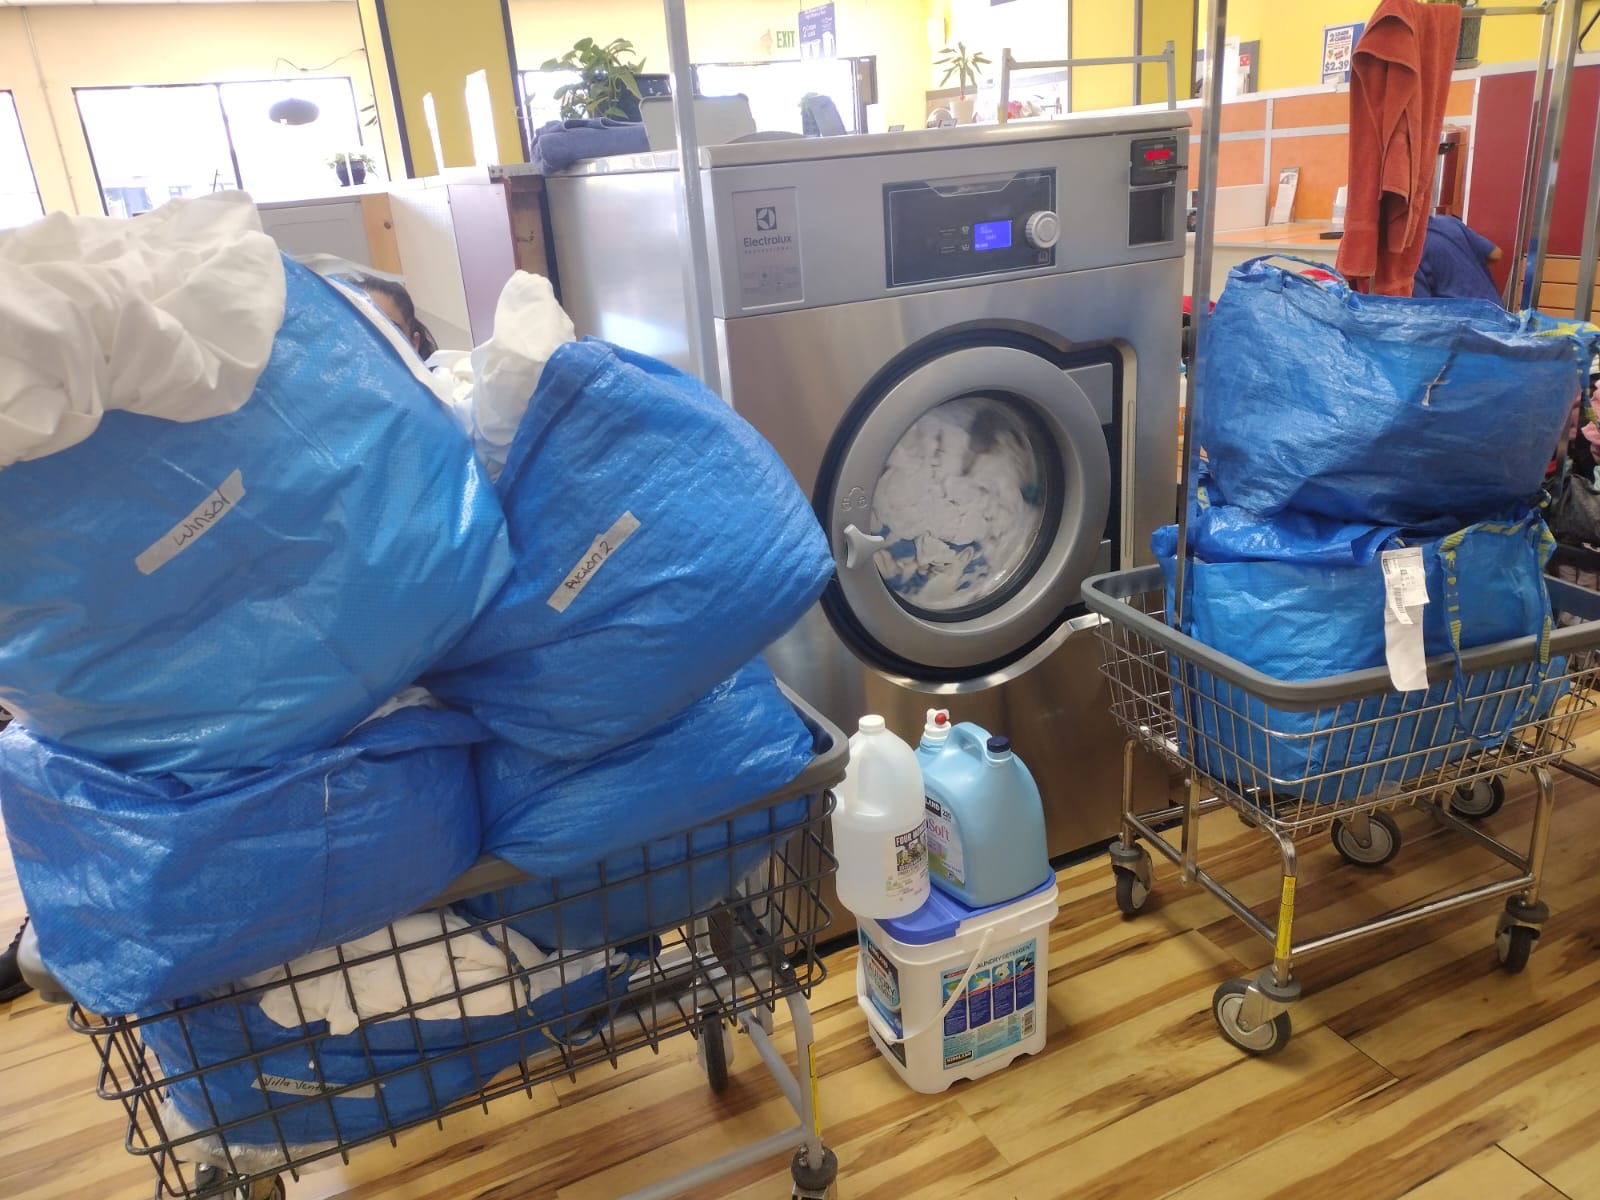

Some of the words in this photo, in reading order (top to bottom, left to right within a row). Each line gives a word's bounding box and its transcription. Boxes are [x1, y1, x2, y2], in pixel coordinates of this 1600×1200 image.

[776, 31, 795, 48] EXIT
[1324, 60, 1349, 72] $2.39
[743, 235, 792, 248] Electrolux
[925, 797, 941, 811] LAND
[896, 833, 913, 847] FOUR
